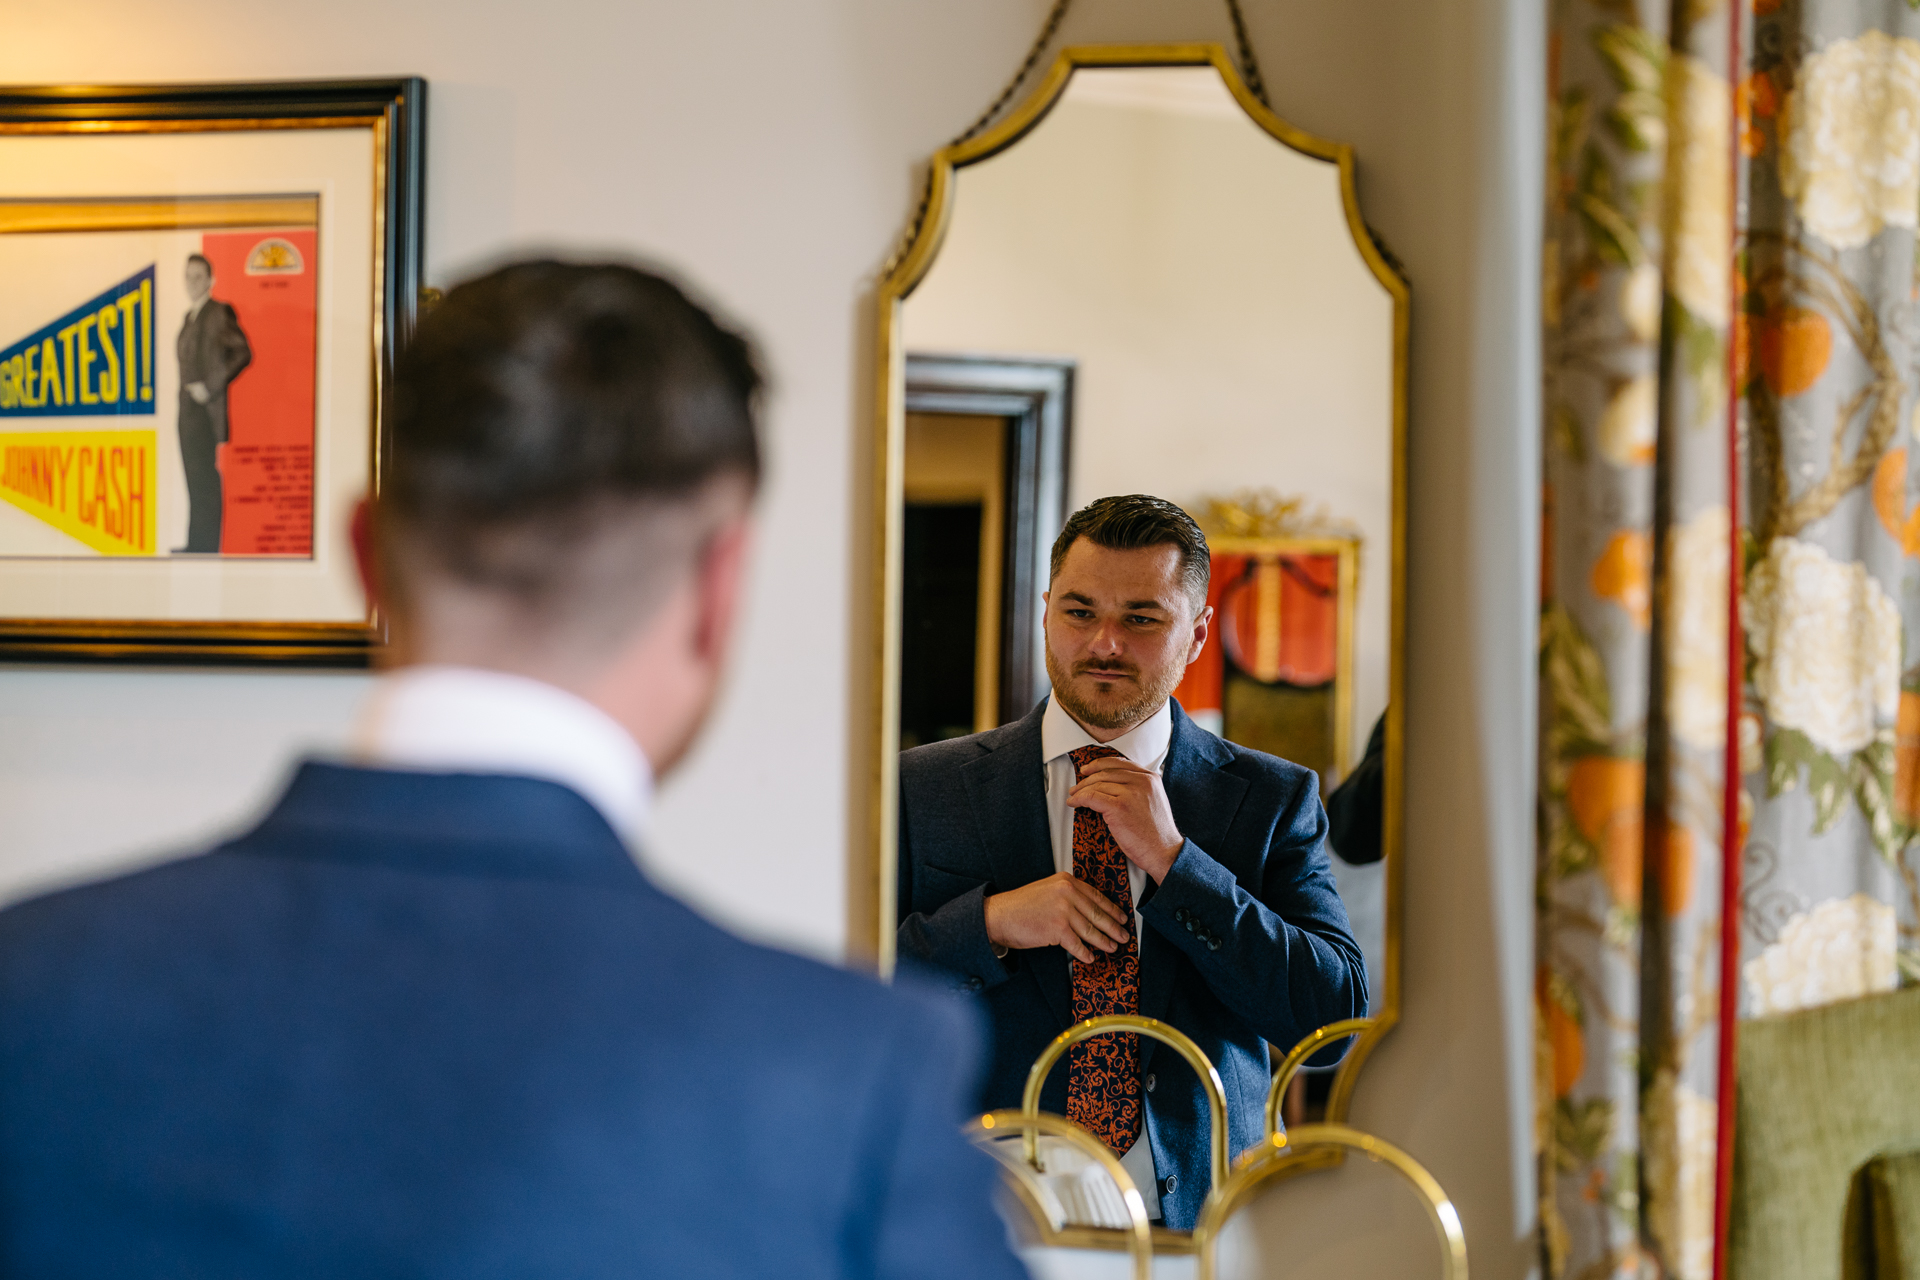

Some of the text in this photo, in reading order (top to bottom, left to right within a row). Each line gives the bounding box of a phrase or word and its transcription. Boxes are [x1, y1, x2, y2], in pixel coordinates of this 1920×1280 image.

[0, 277, 153, 408] GREATEST!
[1, 446, 145, 552] JOHNNY CASH
